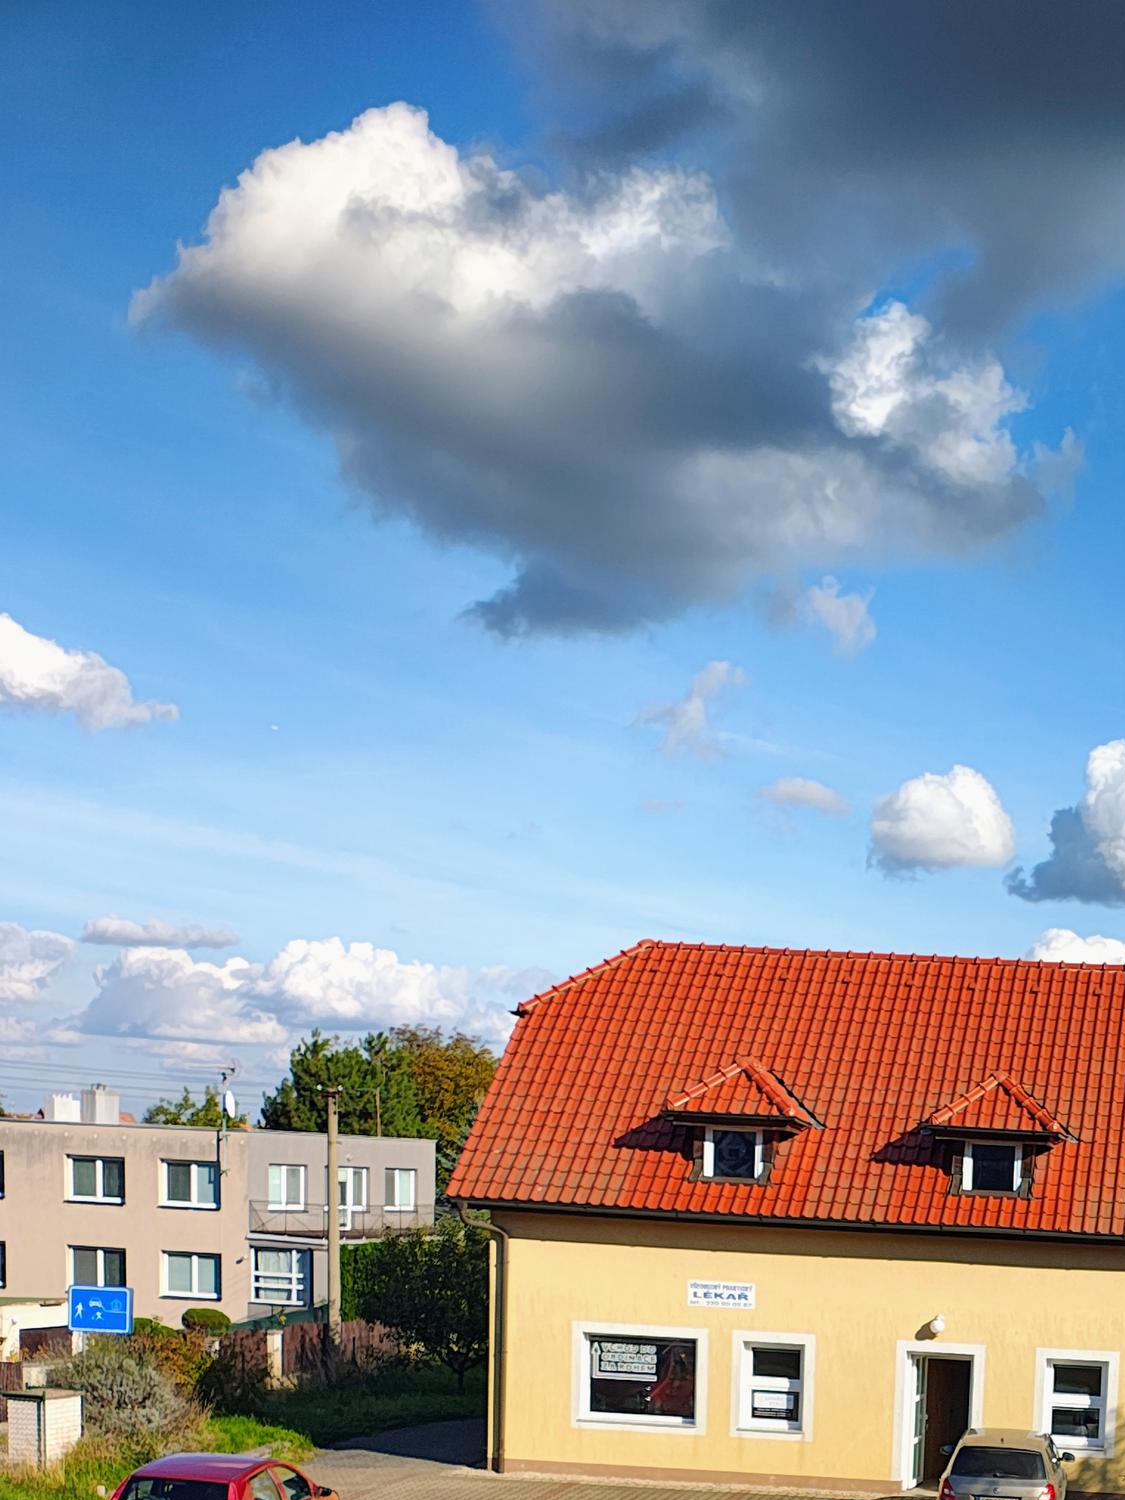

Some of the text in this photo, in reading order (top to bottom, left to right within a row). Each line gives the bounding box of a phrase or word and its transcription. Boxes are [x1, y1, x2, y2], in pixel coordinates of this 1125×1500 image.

[693, 1291, 749, 1301] LÉKAŘ
[601, 1352, 657, 1364] ORDINACE
[617, 1363, 656, 1373] ROHEM
